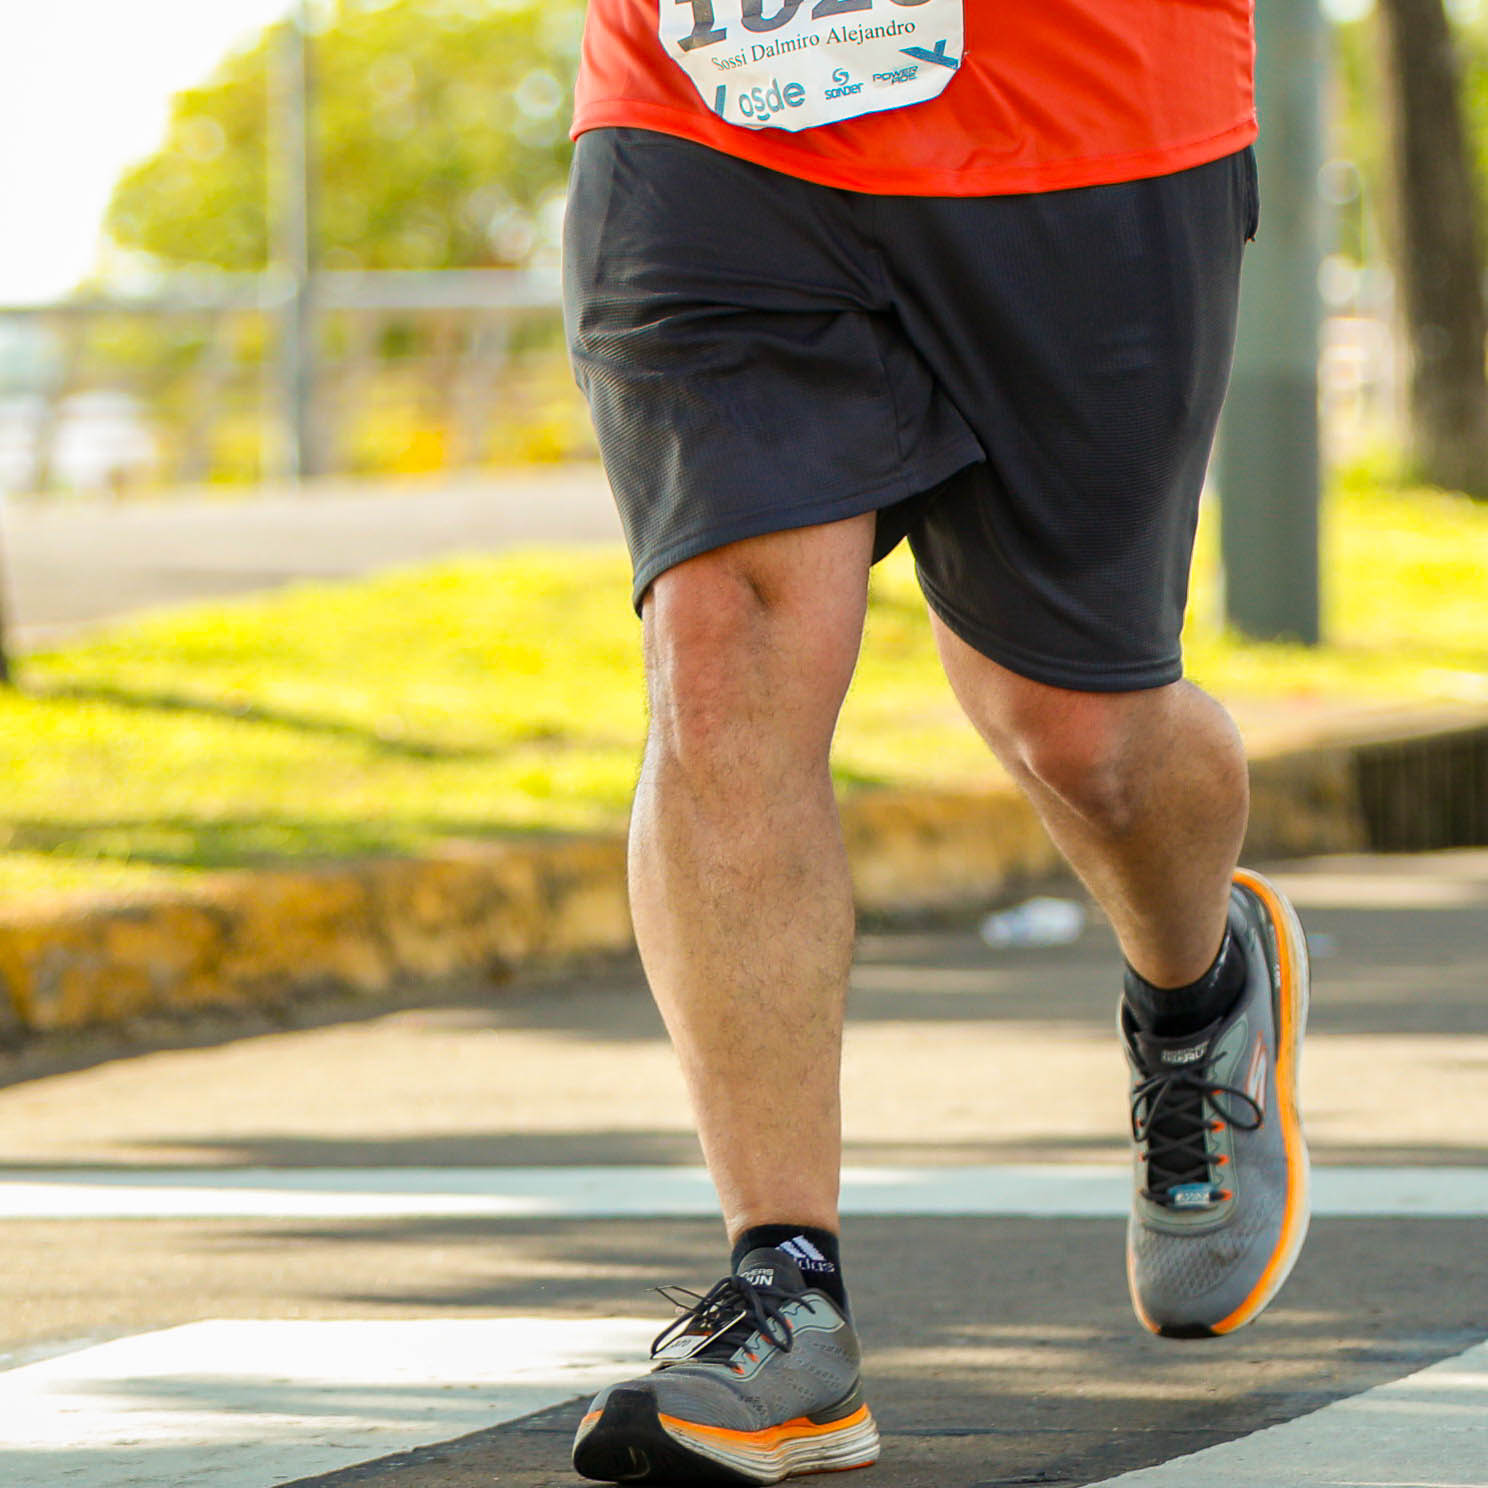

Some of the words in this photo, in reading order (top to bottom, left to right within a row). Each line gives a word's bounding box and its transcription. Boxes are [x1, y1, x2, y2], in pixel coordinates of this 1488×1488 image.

[711, 48, 748, 71] Sossi
[751, 33, 820, 62] Dalmiro
[826, 19, 916, 45] Alejandro
[738, 78, 806, 119] osde
